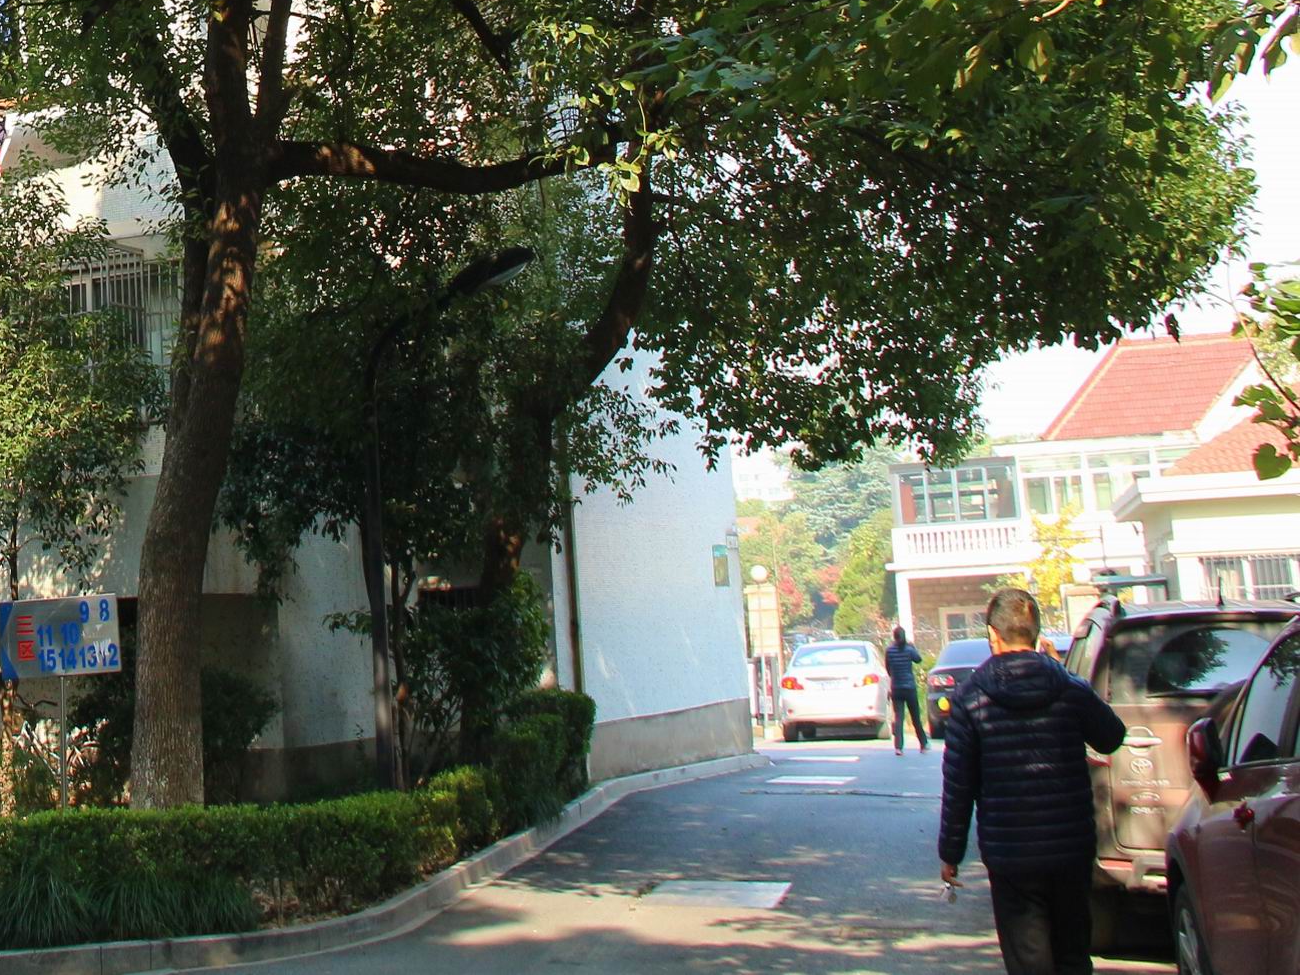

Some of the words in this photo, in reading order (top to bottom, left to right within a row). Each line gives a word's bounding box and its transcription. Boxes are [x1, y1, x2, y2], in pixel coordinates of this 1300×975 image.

[80, 601, 89, 623] 9
[100, 599, 109, 621] 8
[17, 615, 36, 661] 三区
[37, 625, 53, 646] 11
[60, 621, 79, 646] 10
[38, 648, 57, 673] 15
[58, 646, 78, 670] 14
[79, 644, 98, 668] 13
